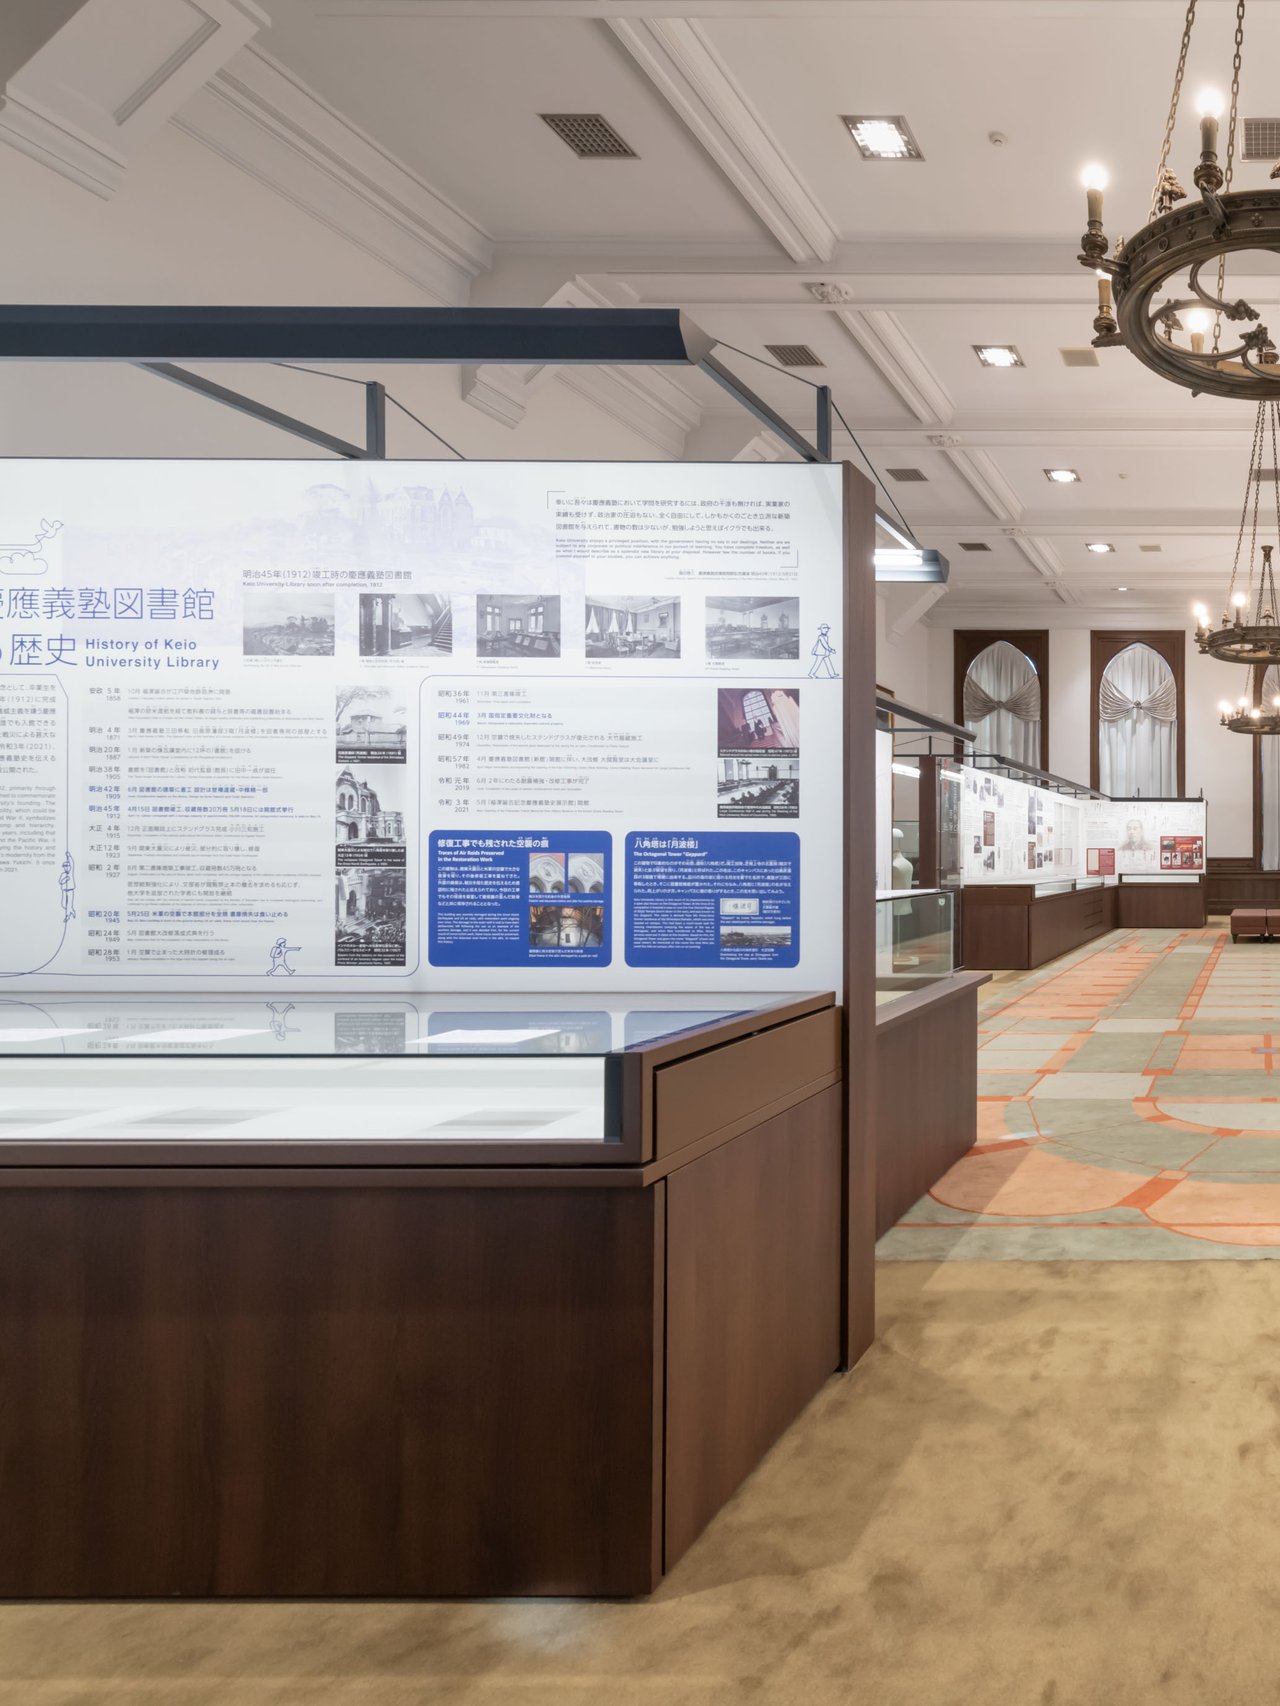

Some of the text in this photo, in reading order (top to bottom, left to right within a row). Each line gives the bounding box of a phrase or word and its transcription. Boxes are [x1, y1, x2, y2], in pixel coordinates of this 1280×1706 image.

[0, 587, 215, 620] 應義塾図書館
[0, 633, 78, 666] 歴史
[85, 639, 197, 653] History of Keio
[85, 656, 219, 670] University Library
